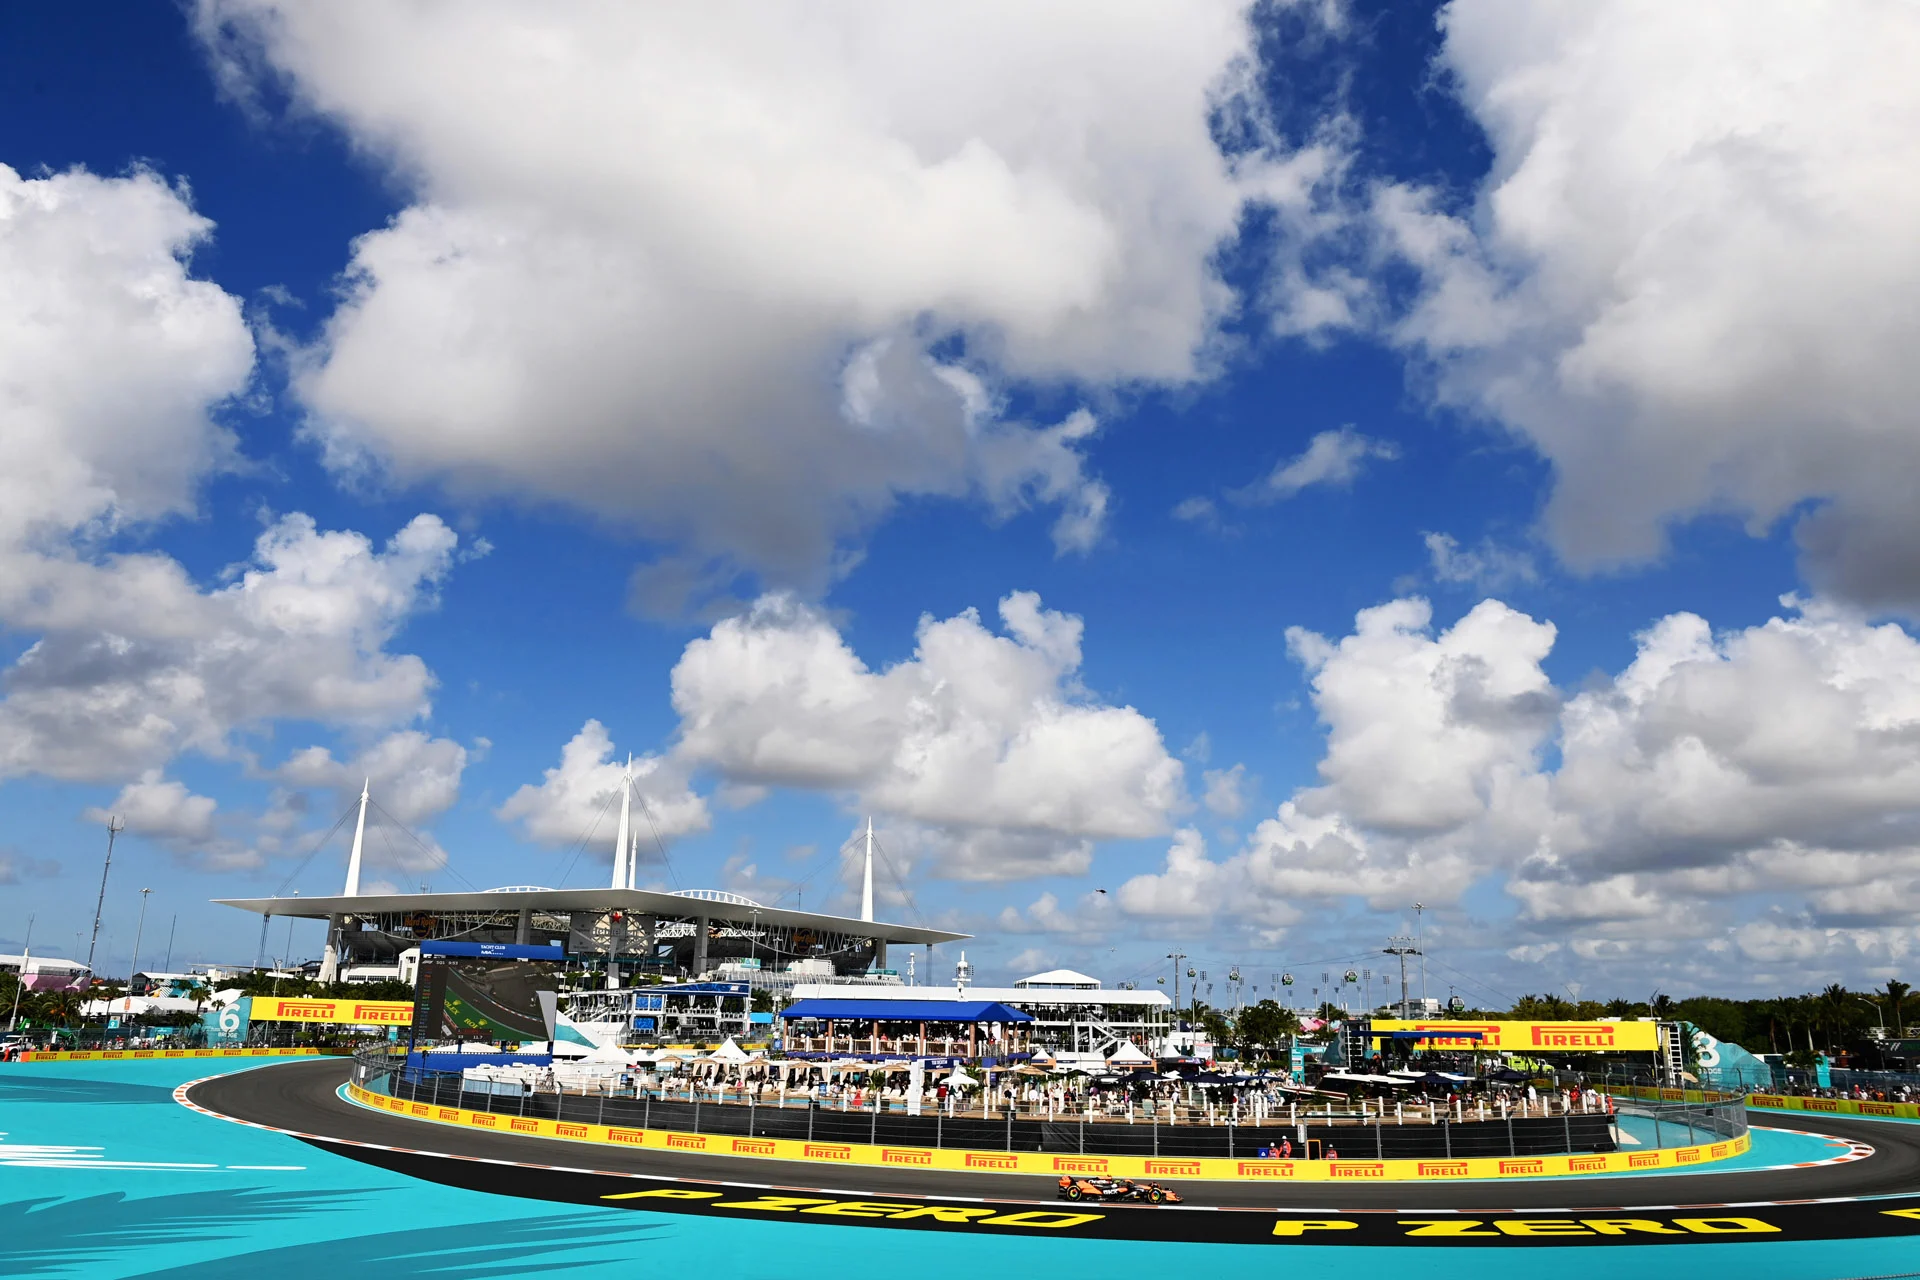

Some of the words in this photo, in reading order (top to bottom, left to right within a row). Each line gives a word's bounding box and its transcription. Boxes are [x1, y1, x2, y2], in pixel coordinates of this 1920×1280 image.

[219, 1003, 240, 1033] 6
[277, 1002, 336, 1018] PIRELLI
[354, 1005, 414, 1021] PIRELLI
[1416, 1026, 1501, 1046] PIRELLI
[1532, 1026, 1614, 1046] PIRELLI
[1692, 1031, 1720, 1067] 8
[1752, 1096, 1784, 1108] PIRELLI
[1804, 1100, 1838, 1111] PIRELLI
[1859, 1103, 1895, 1115] PIRELLI
[412, 1104, 429, 1116] PIRELLI
[440, 1109, 460, 1121] PIRELLI
[472, 1114, 496, 1126] PIRELLI
[511, 1118, 538, 1132] PIRELLI
[556, 1124, 588, 1138] PIRELLI
[608, 1129, 643, 1143] PIRELLI
[667, 1135, 706, 1149] PIRELLI
[732, 1140, 776, 1154] PIRELLI
[804, 1145, 851, 1159] PIRELLI
[882, 1149, 932, 1164] PIRELLI
[1676, 1149, 1700, 1162] PIRELLI
[1711, 1144, 1727, 1158] PIRELLI
[966, 1154, 1018, 1168] PIRELLI
[1053, 1158, 1108, 1172] PIRELLI
[1499, 1160, 1543, 1173] PIRELLI
[1569, 1157, 1607, 1171] PIRELLI
[1629, 1153, 1659, 1167] PIRELLI
[1145, 1161, 1201, 1174] PIRELLI
[1238, 1163, 1294, 1176] PIRELLI
[1330, 1163, 1384, 1176] PIRELLI
[1418, 1162, 1468, 1175] PIRELLI
[600, 1190, 723, 1200] P
[711, 1197, 1105, 1228] ZERO
[1272, 1220, 1358, 1236] P
[1397, 1218, 1783, 1237] ZERO
